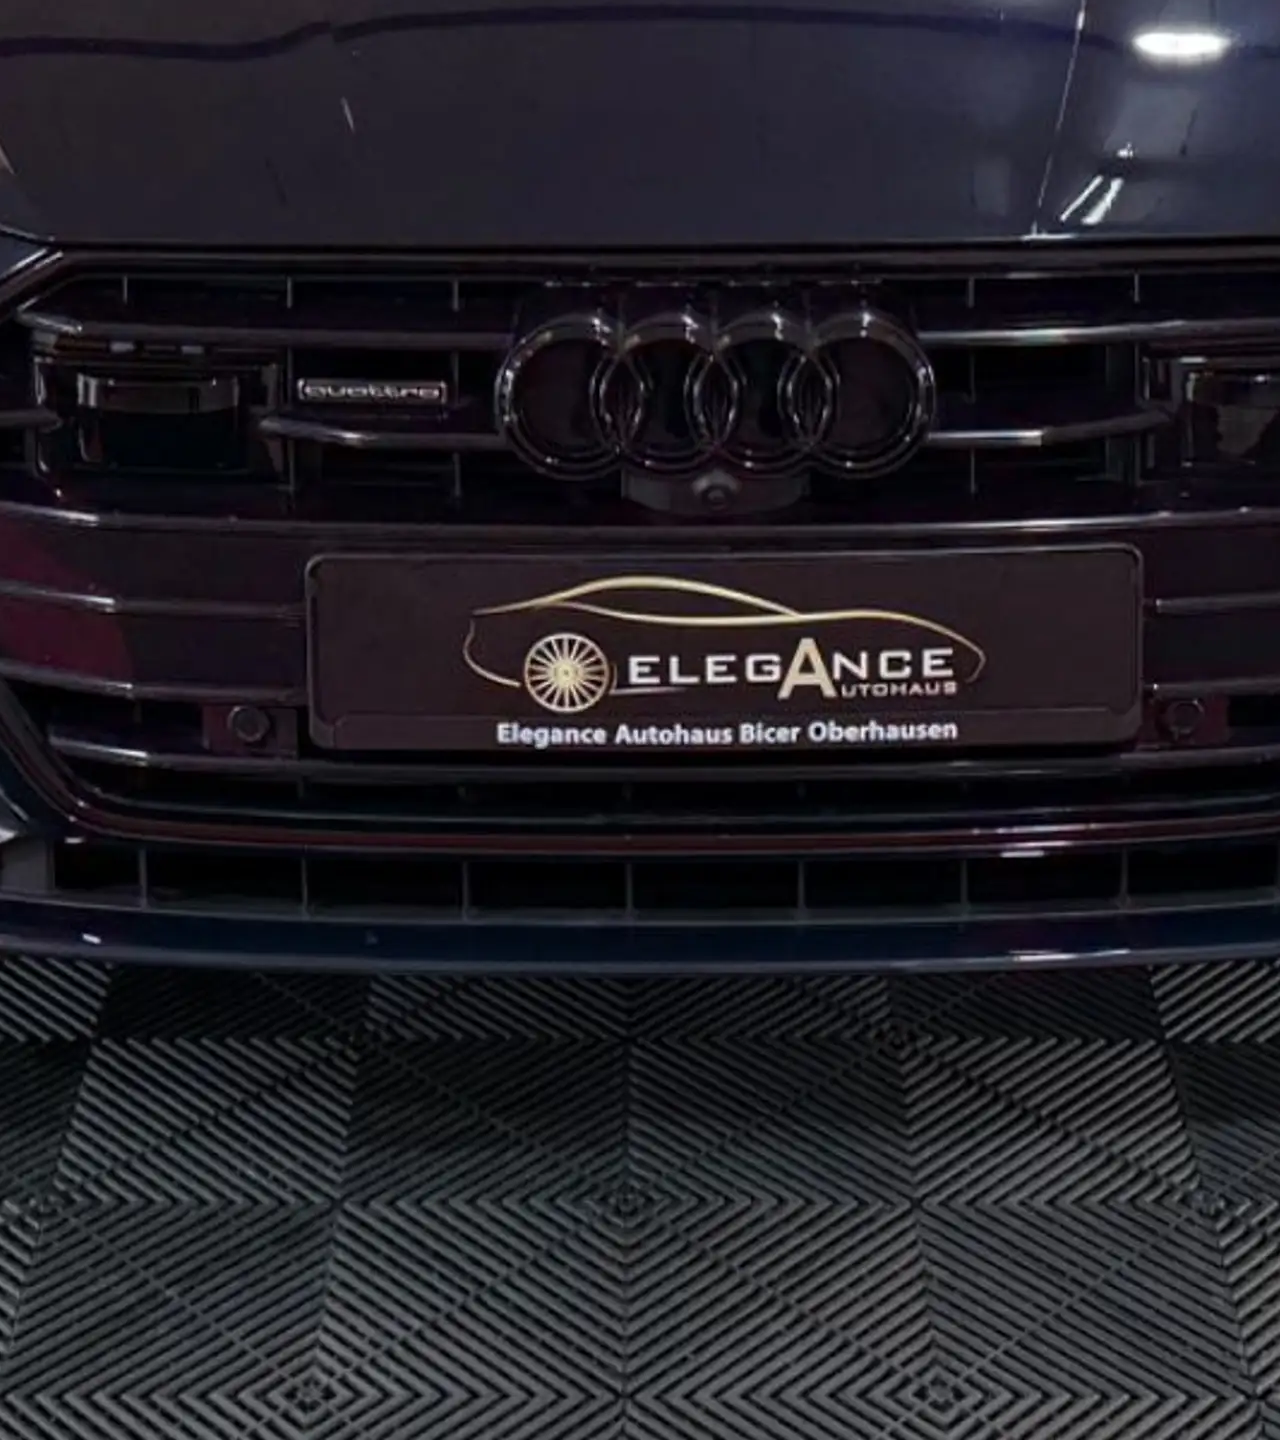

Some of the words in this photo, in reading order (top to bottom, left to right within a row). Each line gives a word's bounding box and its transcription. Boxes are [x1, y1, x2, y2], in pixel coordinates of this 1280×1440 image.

[305, 383, 439, 401] quattro
[628, 638, 954, 699] ELEGANCE
[496, 722, 607, 750] Elegance
[615, 723, 732, 745] Autohaus
[739, 722, 801, 744] Bicer
[808, 720, 957, 743] Oberhausen
